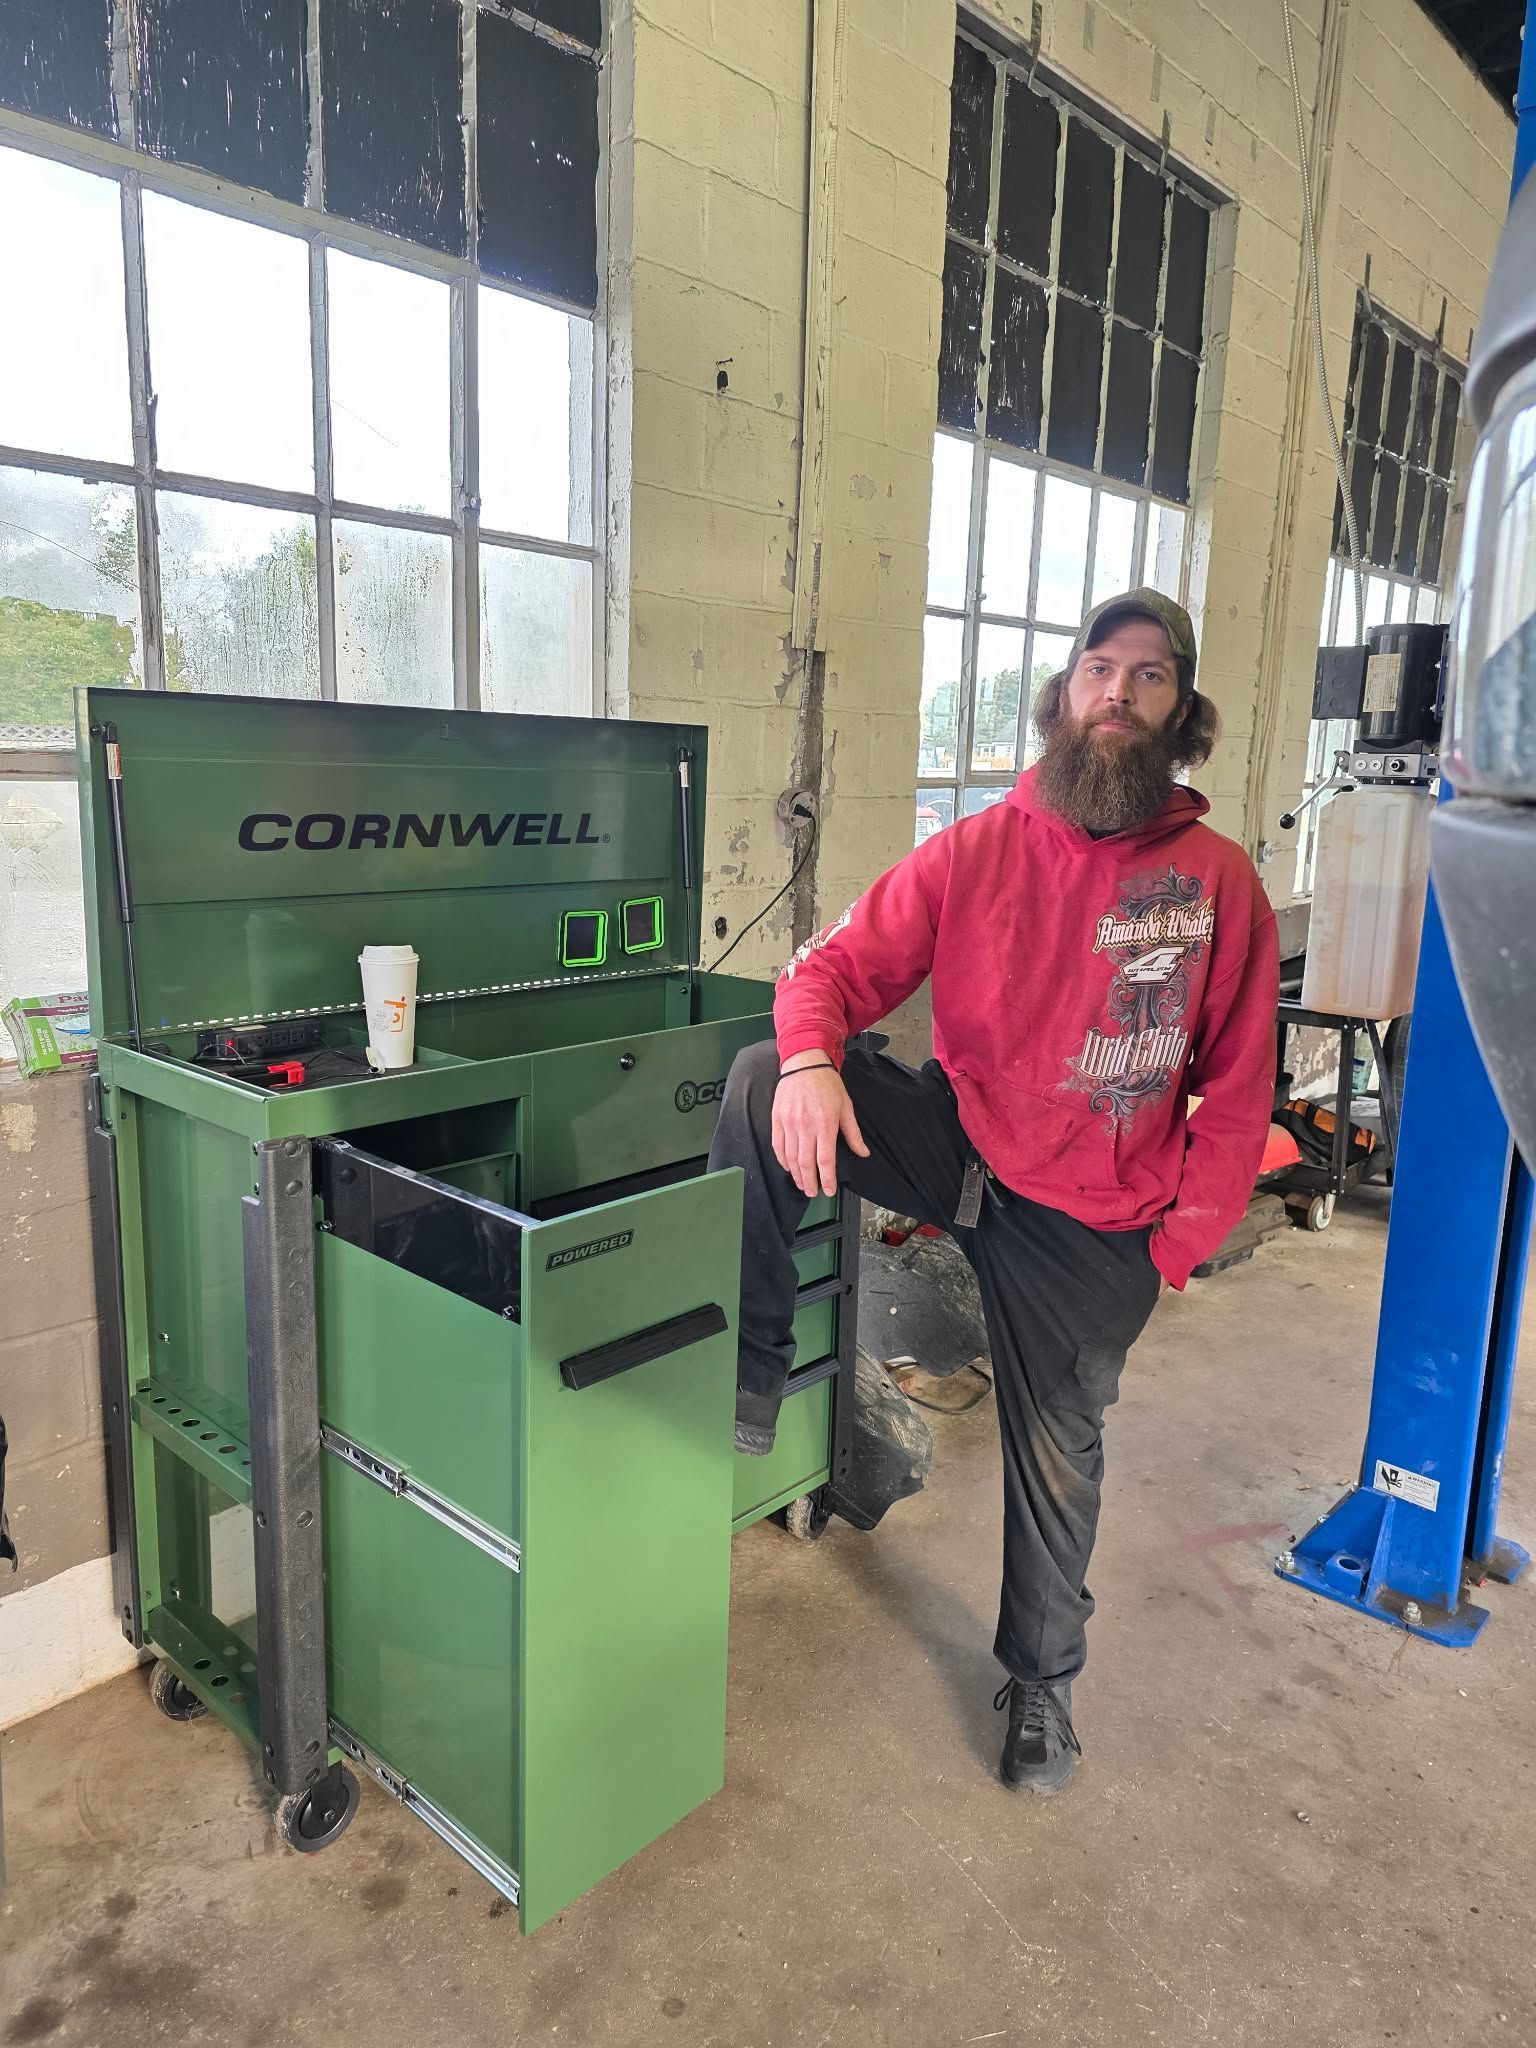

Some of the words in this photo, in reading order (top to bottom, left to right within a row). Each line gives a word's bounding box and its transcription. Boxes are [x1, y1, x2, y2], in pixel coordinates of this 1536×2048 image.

[1093, 904, 1162, 954] Amanda
[1121, 944, 1189, 985] 4
[1080, 1028, 1134, 1079] Wild
[1131, 1025, 1188, 1072] Child
[551, 1233, 630, 1268] POWERED
